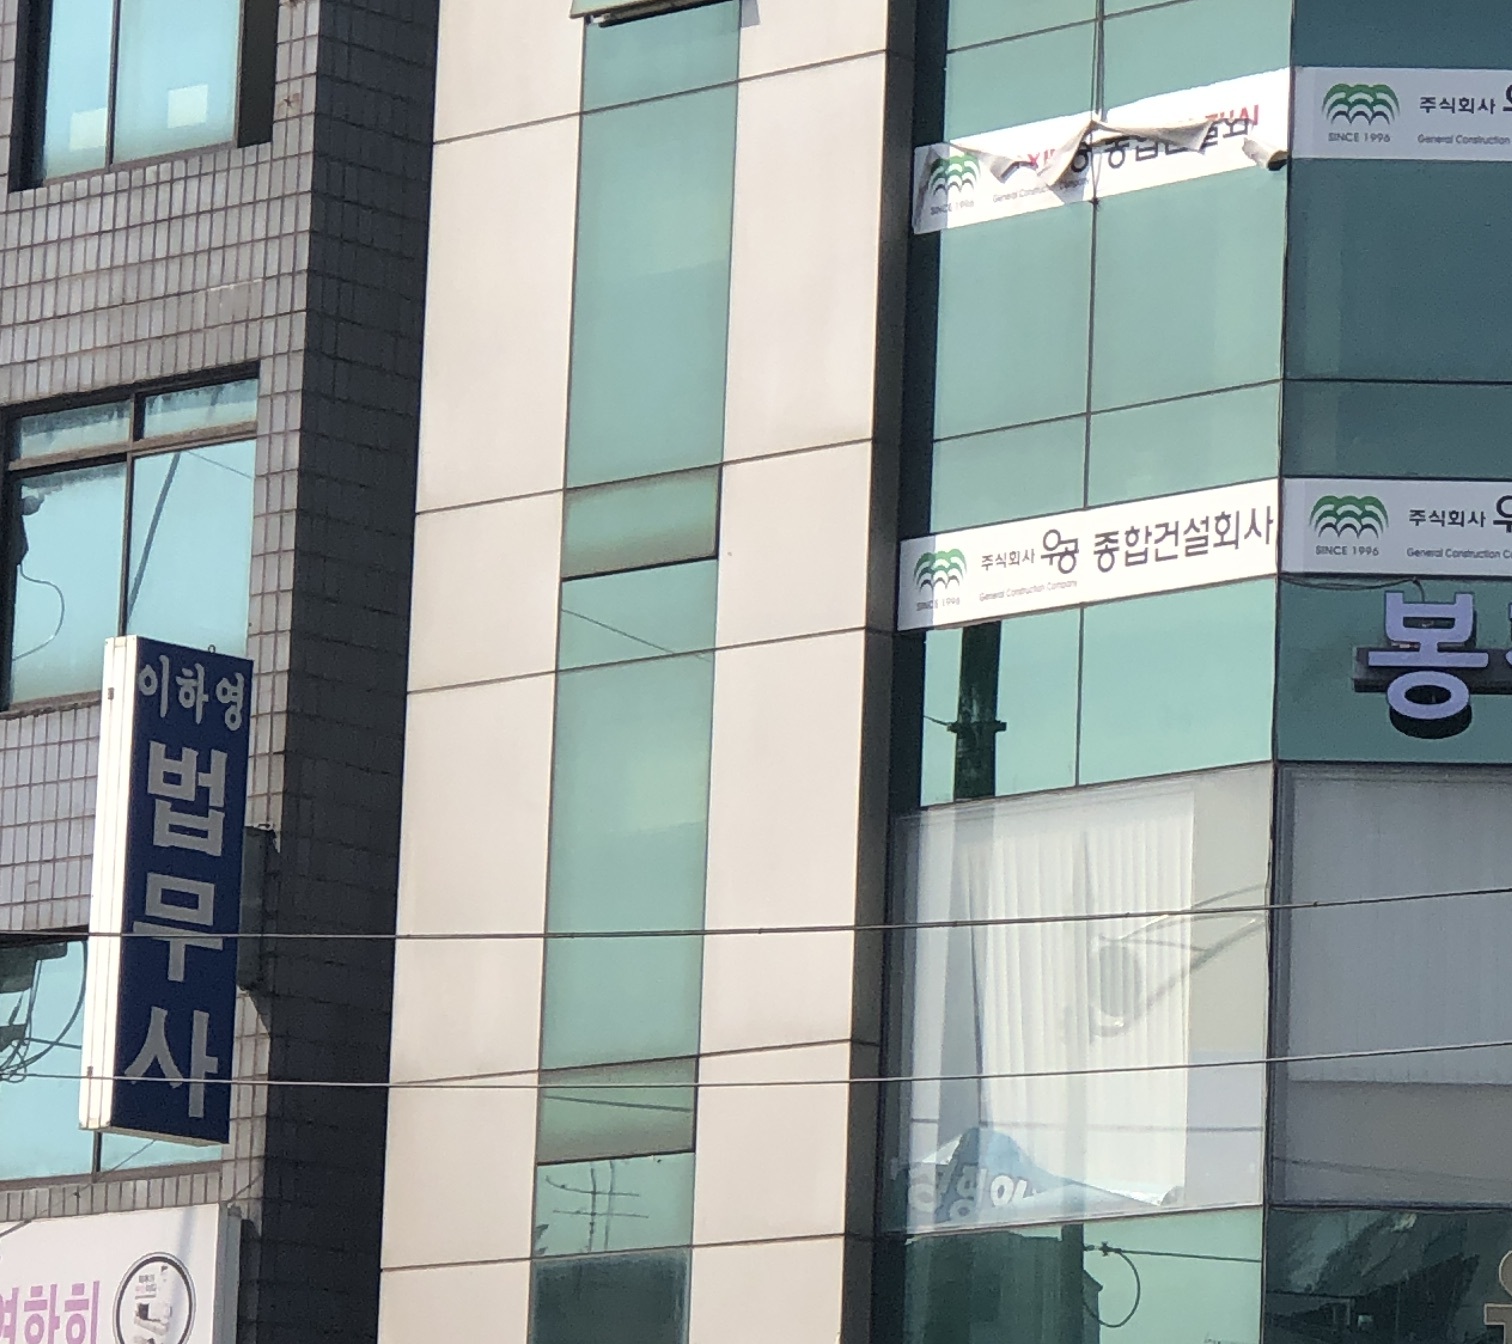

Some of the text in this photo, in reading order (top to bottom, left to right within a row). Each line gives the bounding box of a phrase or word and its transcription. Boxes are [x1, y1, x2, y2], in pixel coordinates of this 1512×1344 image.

[1419, 94, 1496, 116] 주식회사
[1328, 132, 1361, 143] SINCE
[1408, 507, 1486, 528] 주식회사
[981, 548, 1036, 573] 주식회사
[1092, 504, 1274, 574] 종합건설회사
[1315, 544, 1348, 555] SINCE
[138, 655, 246, 732] 이하영
[123, 739, 229, 1119] 법무사
